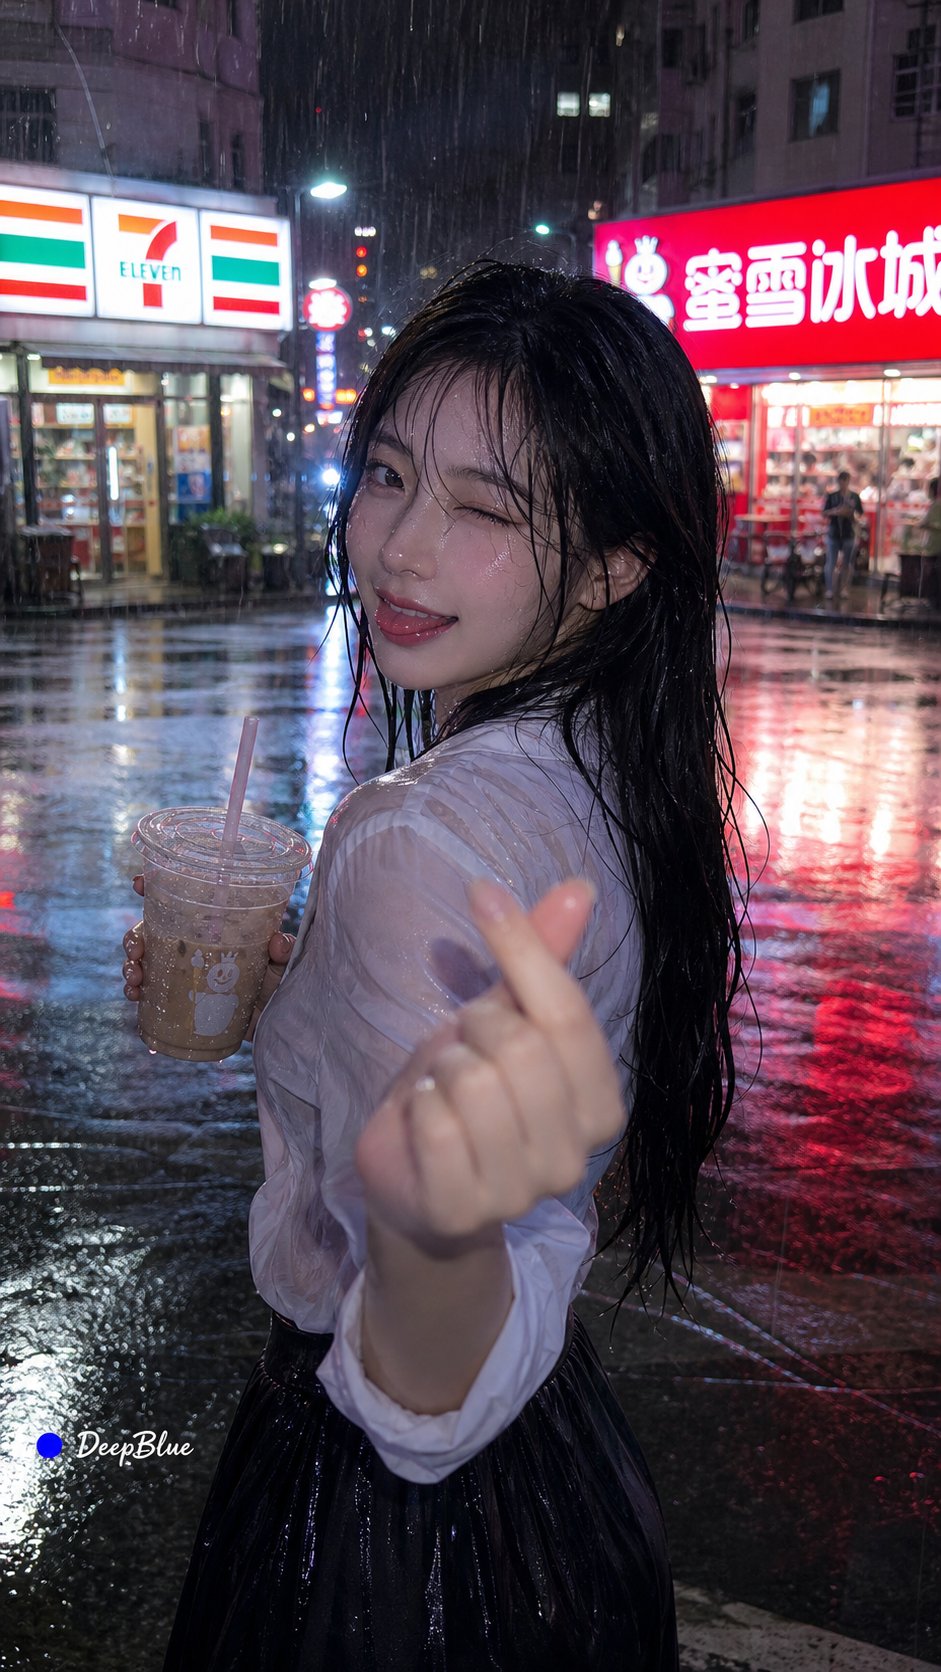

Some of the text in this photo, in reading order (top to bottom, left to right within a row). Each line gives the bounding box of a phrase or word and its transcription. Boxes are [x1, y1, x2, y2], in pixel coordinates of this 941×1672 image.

[119, 214, 178, 308] 7
[682, 224, 941, 332] 蜜雪冰城
